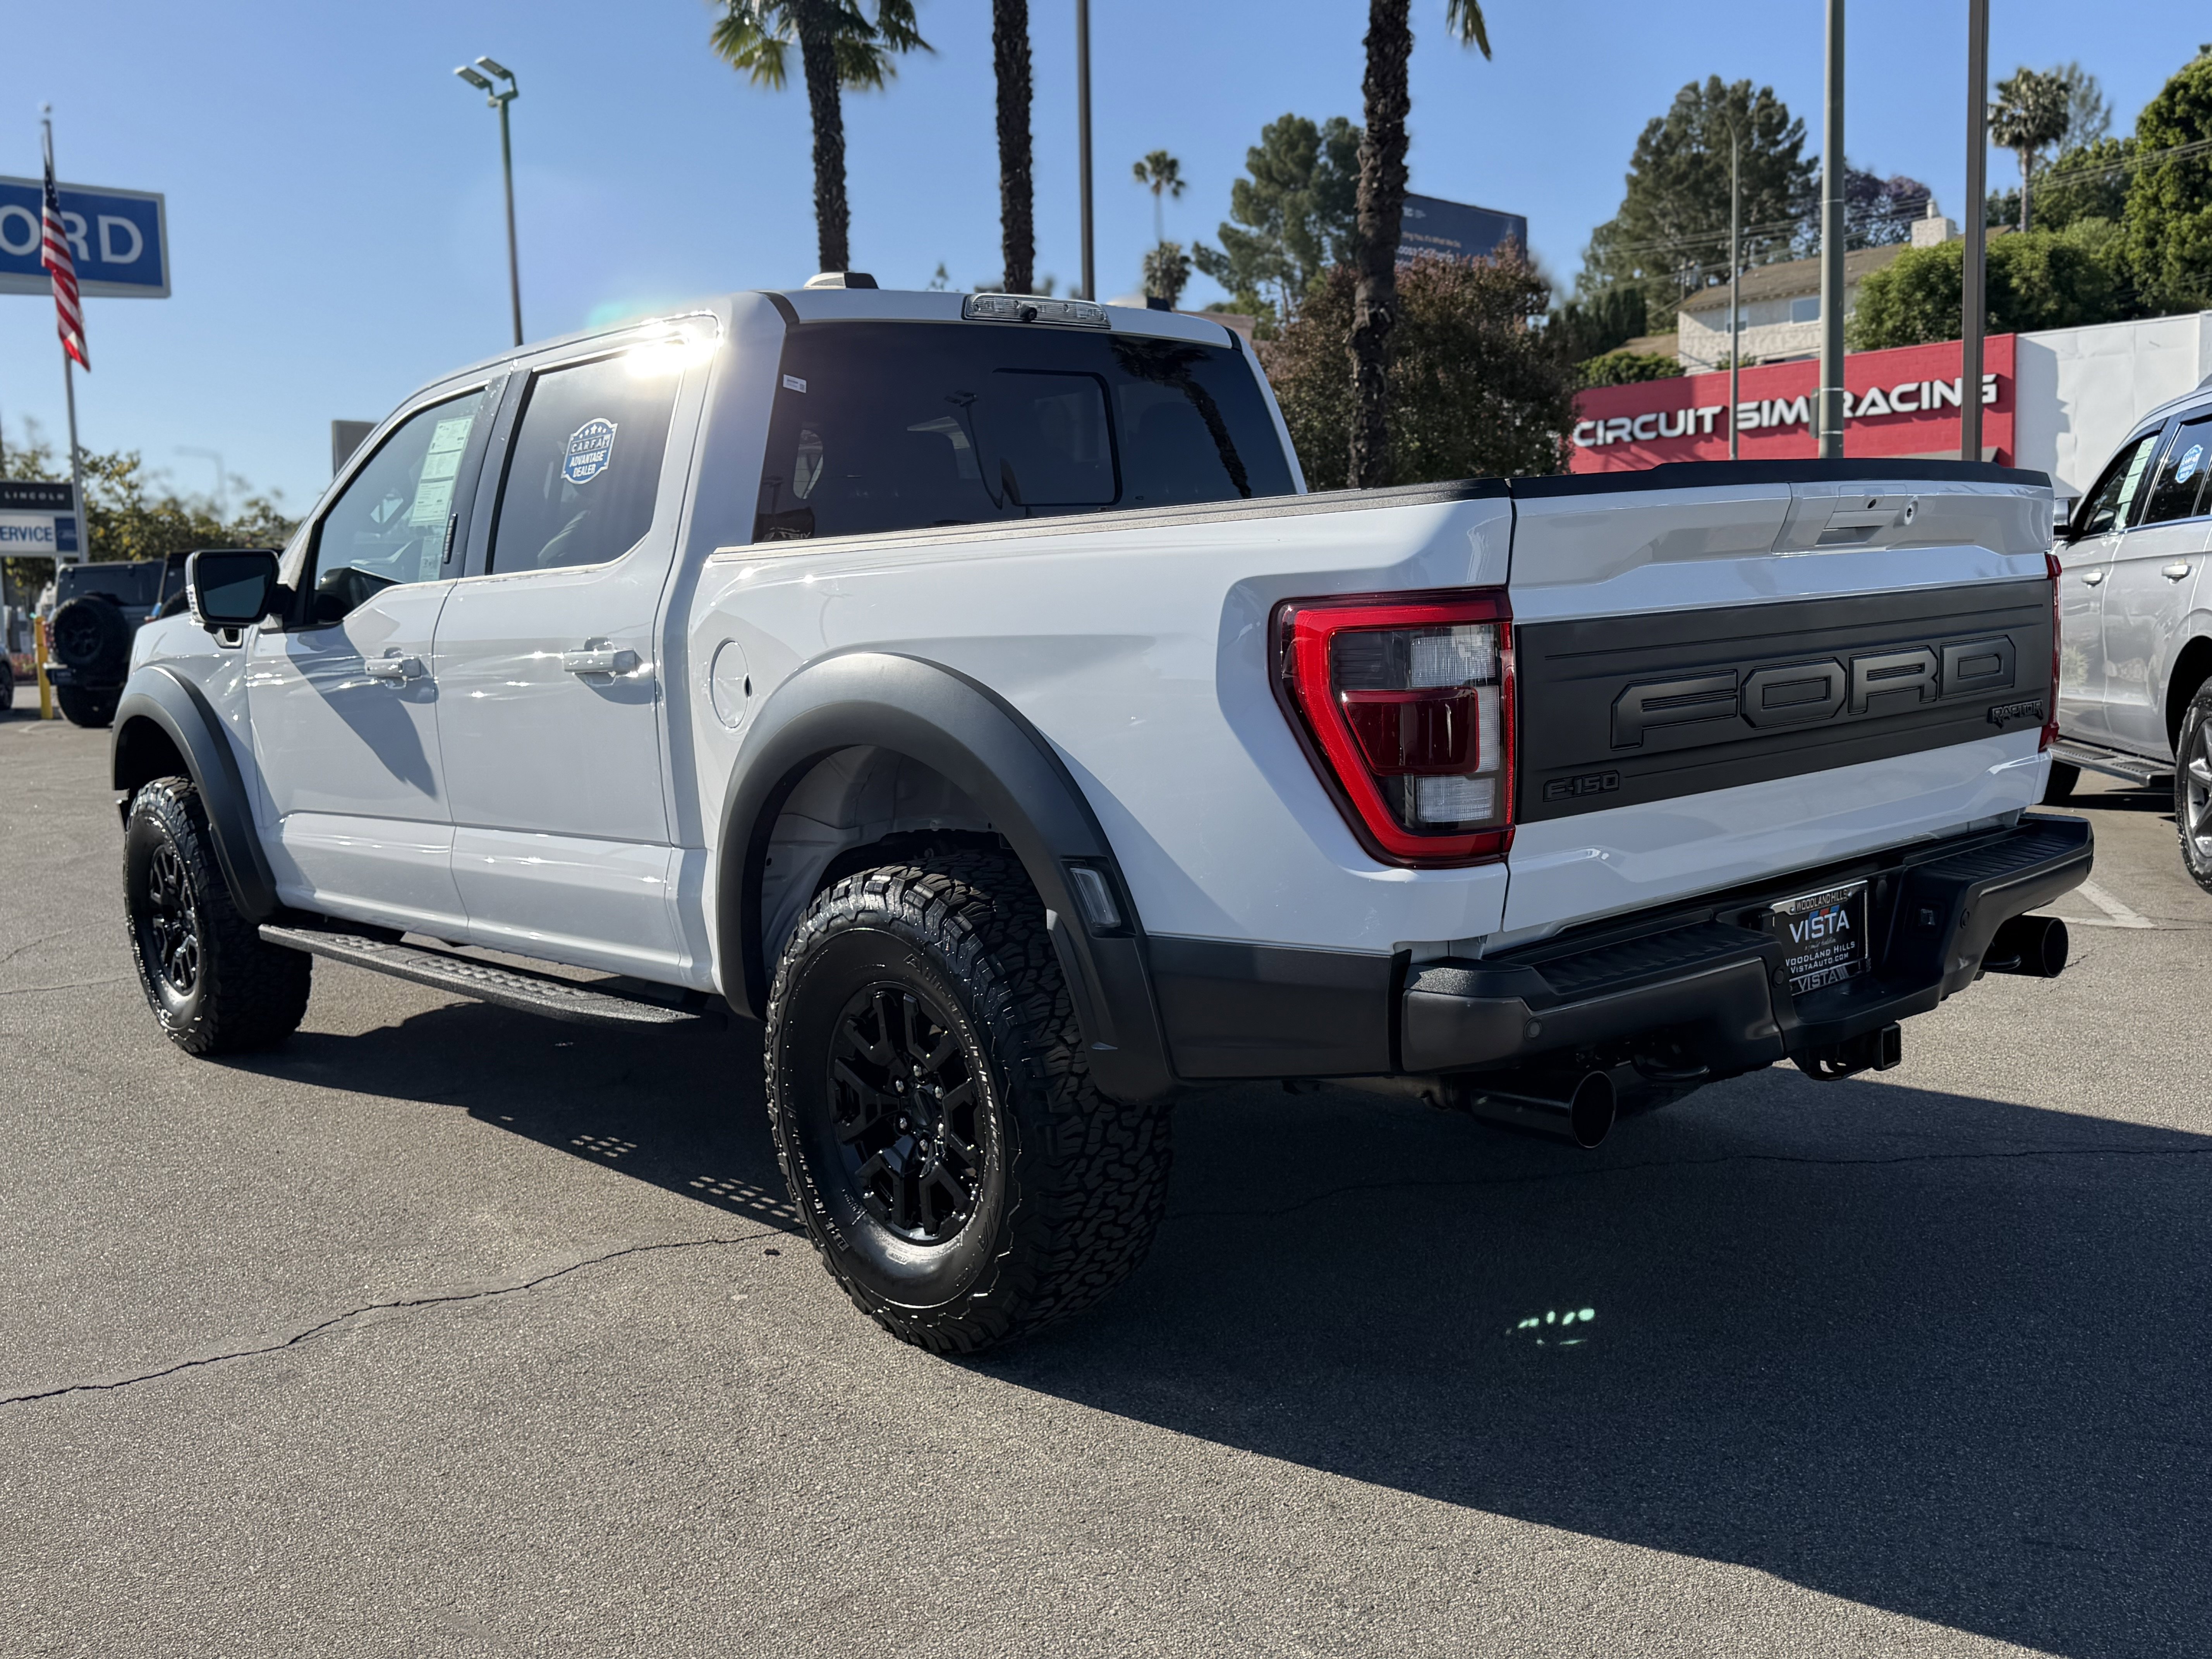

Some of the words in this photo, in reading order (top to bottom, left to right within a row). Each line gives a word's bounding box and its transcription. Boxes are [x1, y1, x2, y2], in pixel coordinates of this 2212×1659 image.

[1572, 405, 1723, 447] CIRCUIT
[1737, 394, 1810, 431] SIM
[571, 436, 610, 453] CARFAX
[569, 452, 604, 467] ADVANTAGE
[572, 464, 596, 478] DEALER
[3, 490, 65, 501] LINCOLN
[1610, 634, 2016, 751] FORD
[1990, 699, 2044, 728] RAPTOR
[1546, 773, 1619, 800] F-150
[1795, 893, 1831, 912] WOODLAND
[1831, 889, 1848, 902] HILLS
[1789, 910, 1850, 943] VISTA
[1798, 968, 1838, 991] VISTA
